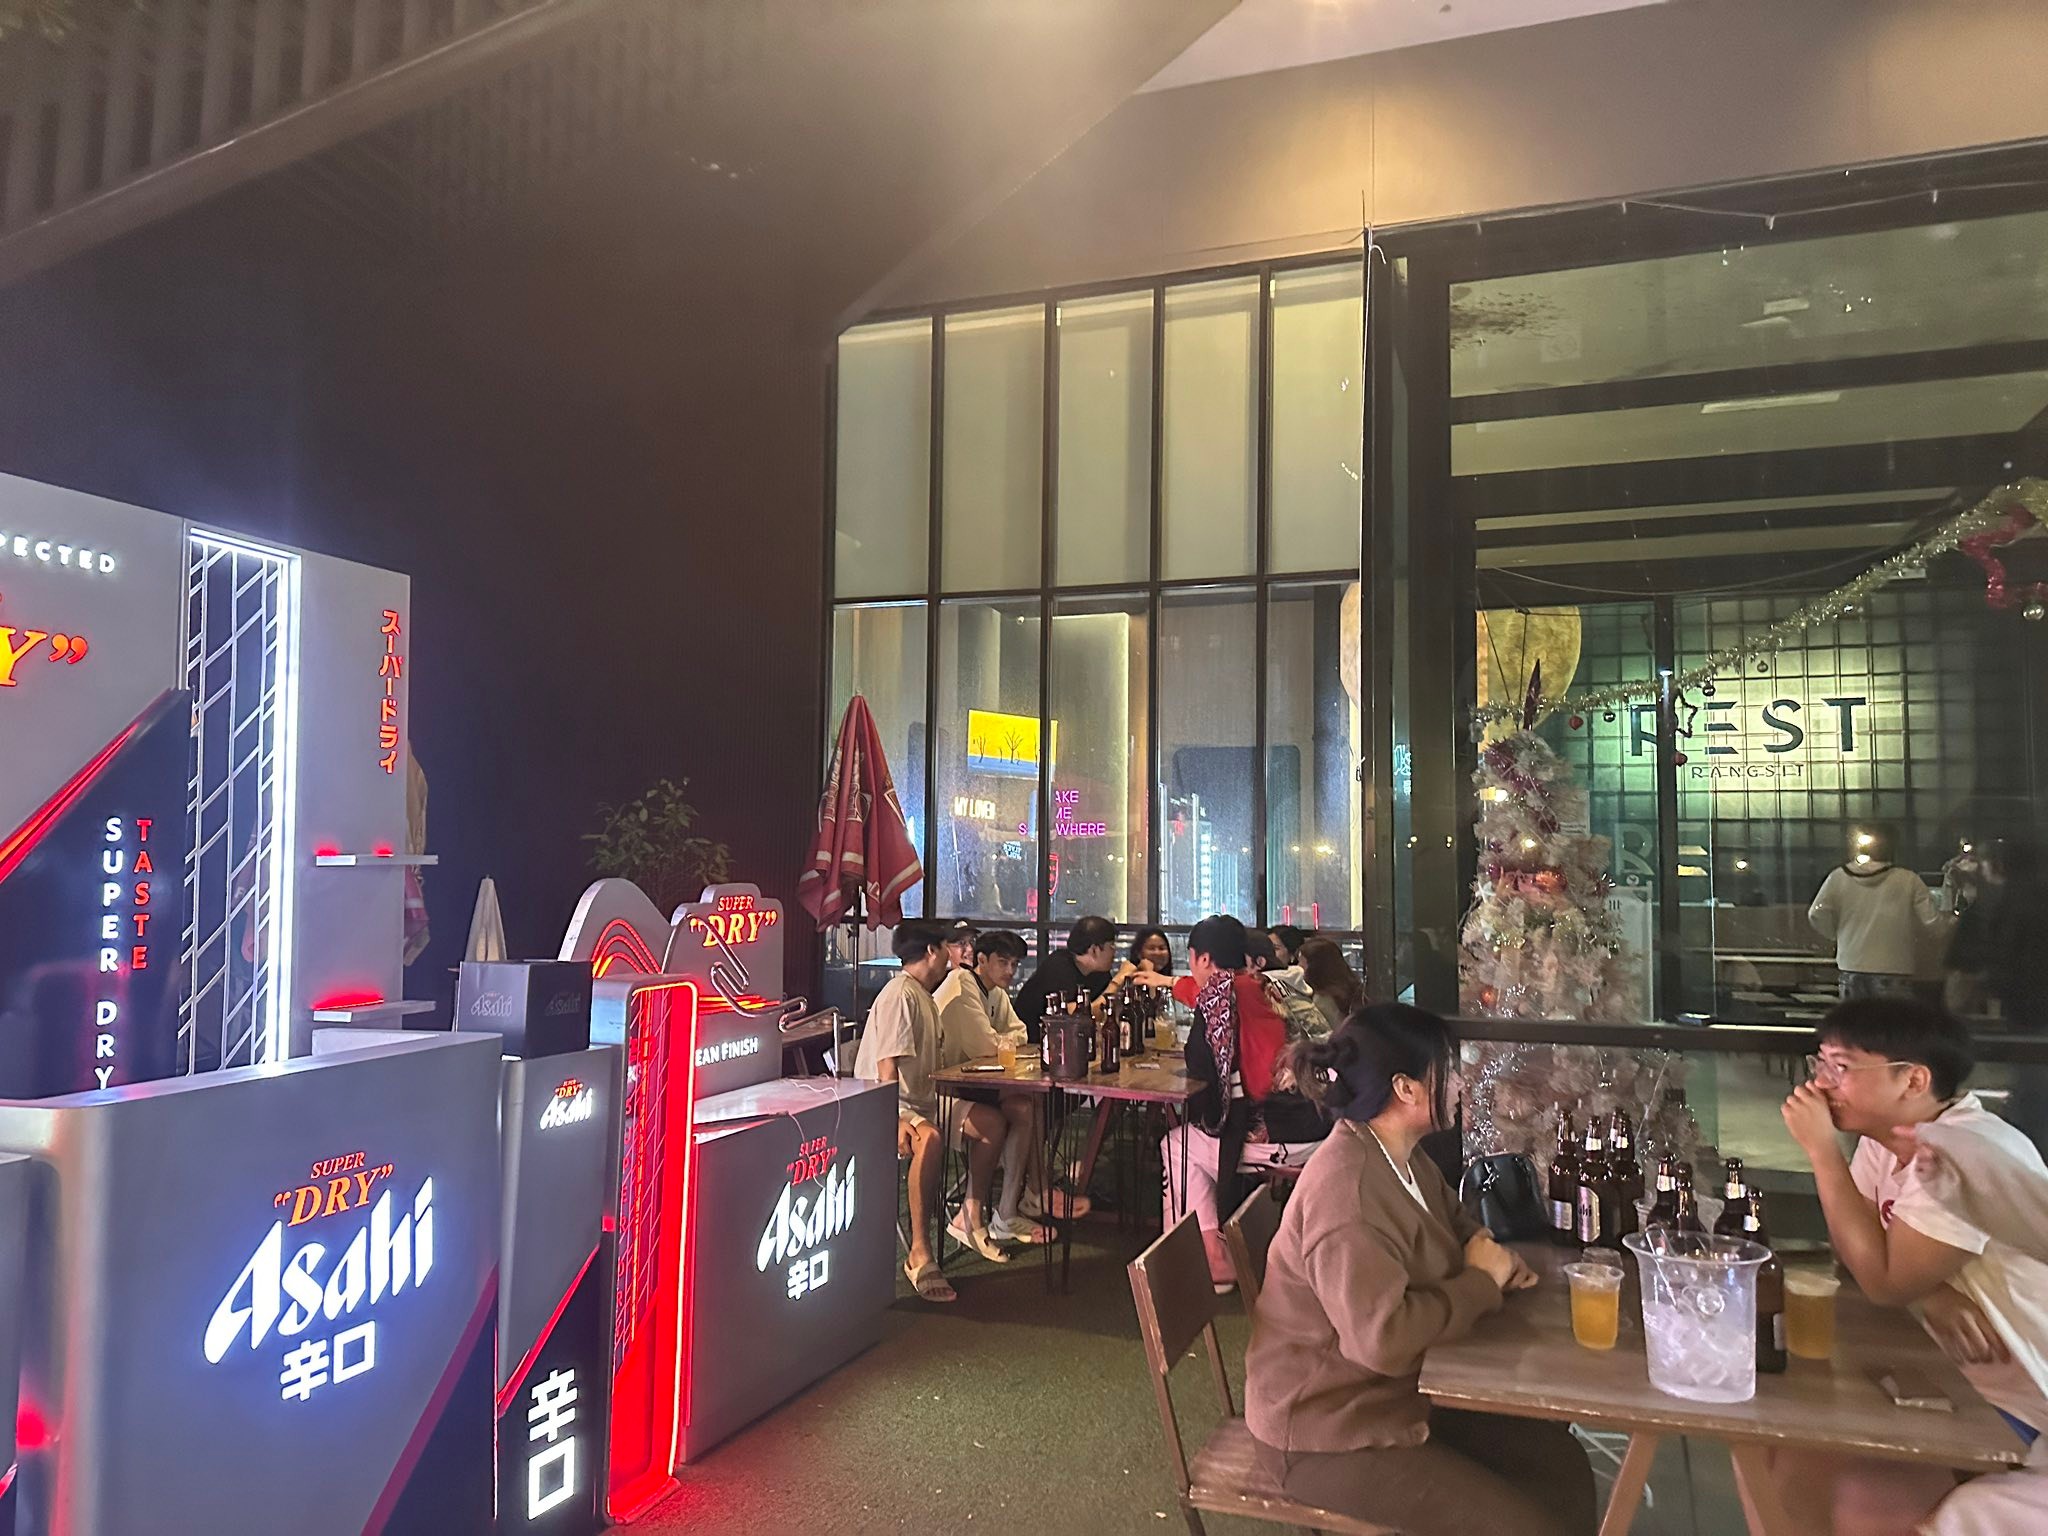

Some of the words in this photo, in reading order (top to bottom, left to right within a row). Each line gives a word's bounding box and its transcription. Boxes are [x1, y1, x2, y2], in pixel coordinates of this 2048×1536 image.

[379, 610, 403, 774] スーパードライ
[1056, 790, 1080, 803] AKE
[1691, 763, 1804, 779] RANGSIT
[100, 817, 123, 973] SUPER
[131, 818, 153, 970] TASTE
[718, 895, 754, 912] SUPER
[95, 1001, 118, 1091] DRY
[695, 1045, 720, 1067] EAN
[721, 1037, 759, 1061] FINISH
[540, 1088, 593, 1131] Asahi
[311, 1151, 365, 1179] SUPER
[756, 1155, 855, 1273] Asahi
[204, 1176, 433, 1364] Asahi
[787, 1249, 829, 1300] 辛口
[280, 1320, 376, 1401] 辛口
[527, 1368, 578, 1520] 辛口
